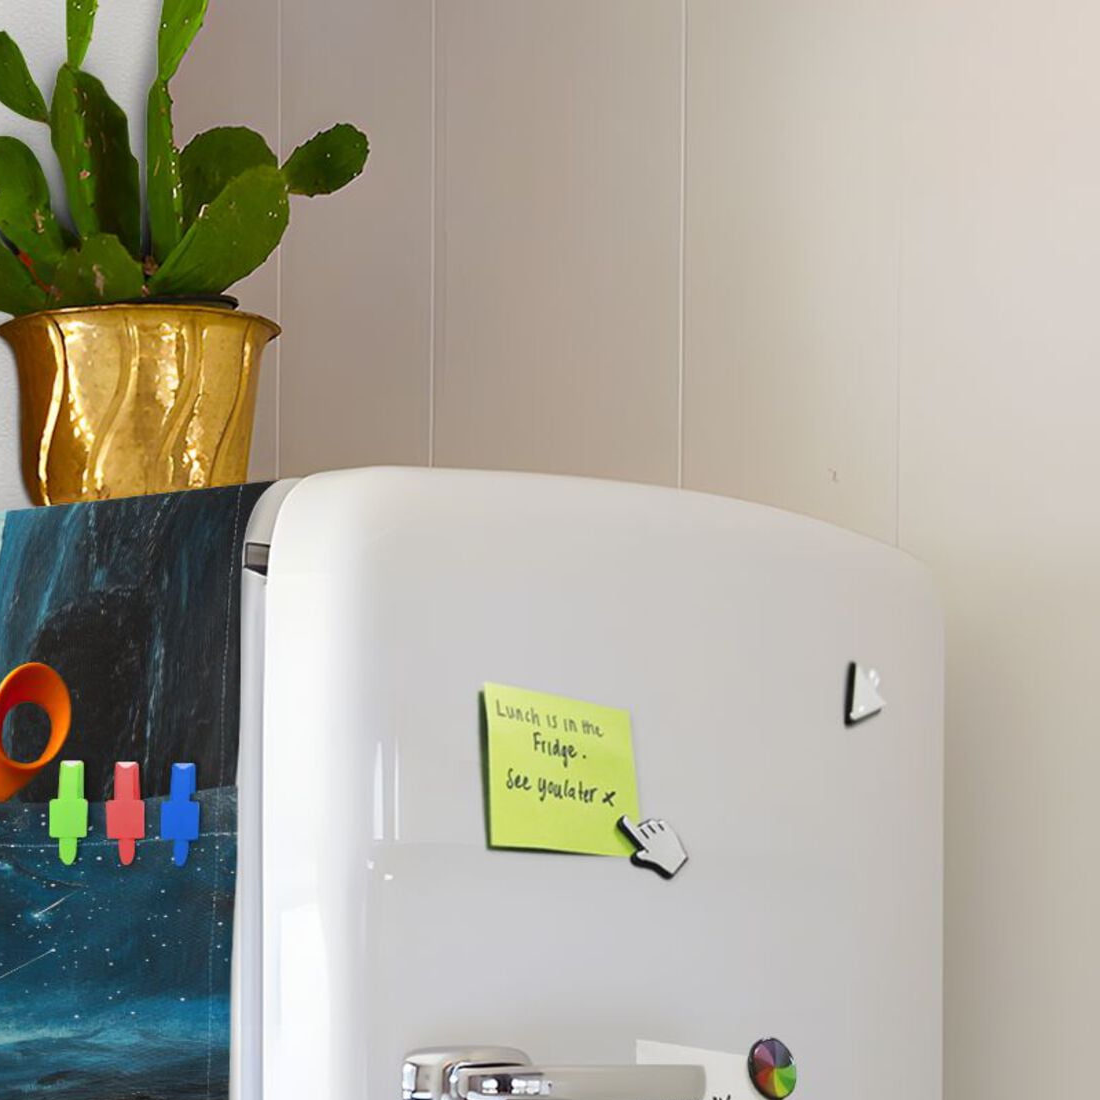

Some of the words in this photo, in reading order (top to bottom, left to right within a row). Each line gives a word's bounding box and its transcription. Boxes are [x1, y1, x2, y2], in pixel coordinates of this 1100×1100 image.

[496, 699, 540, 727] Lunch
[581, 719, 604, 738] the
[506, 767, 532, 790] See
